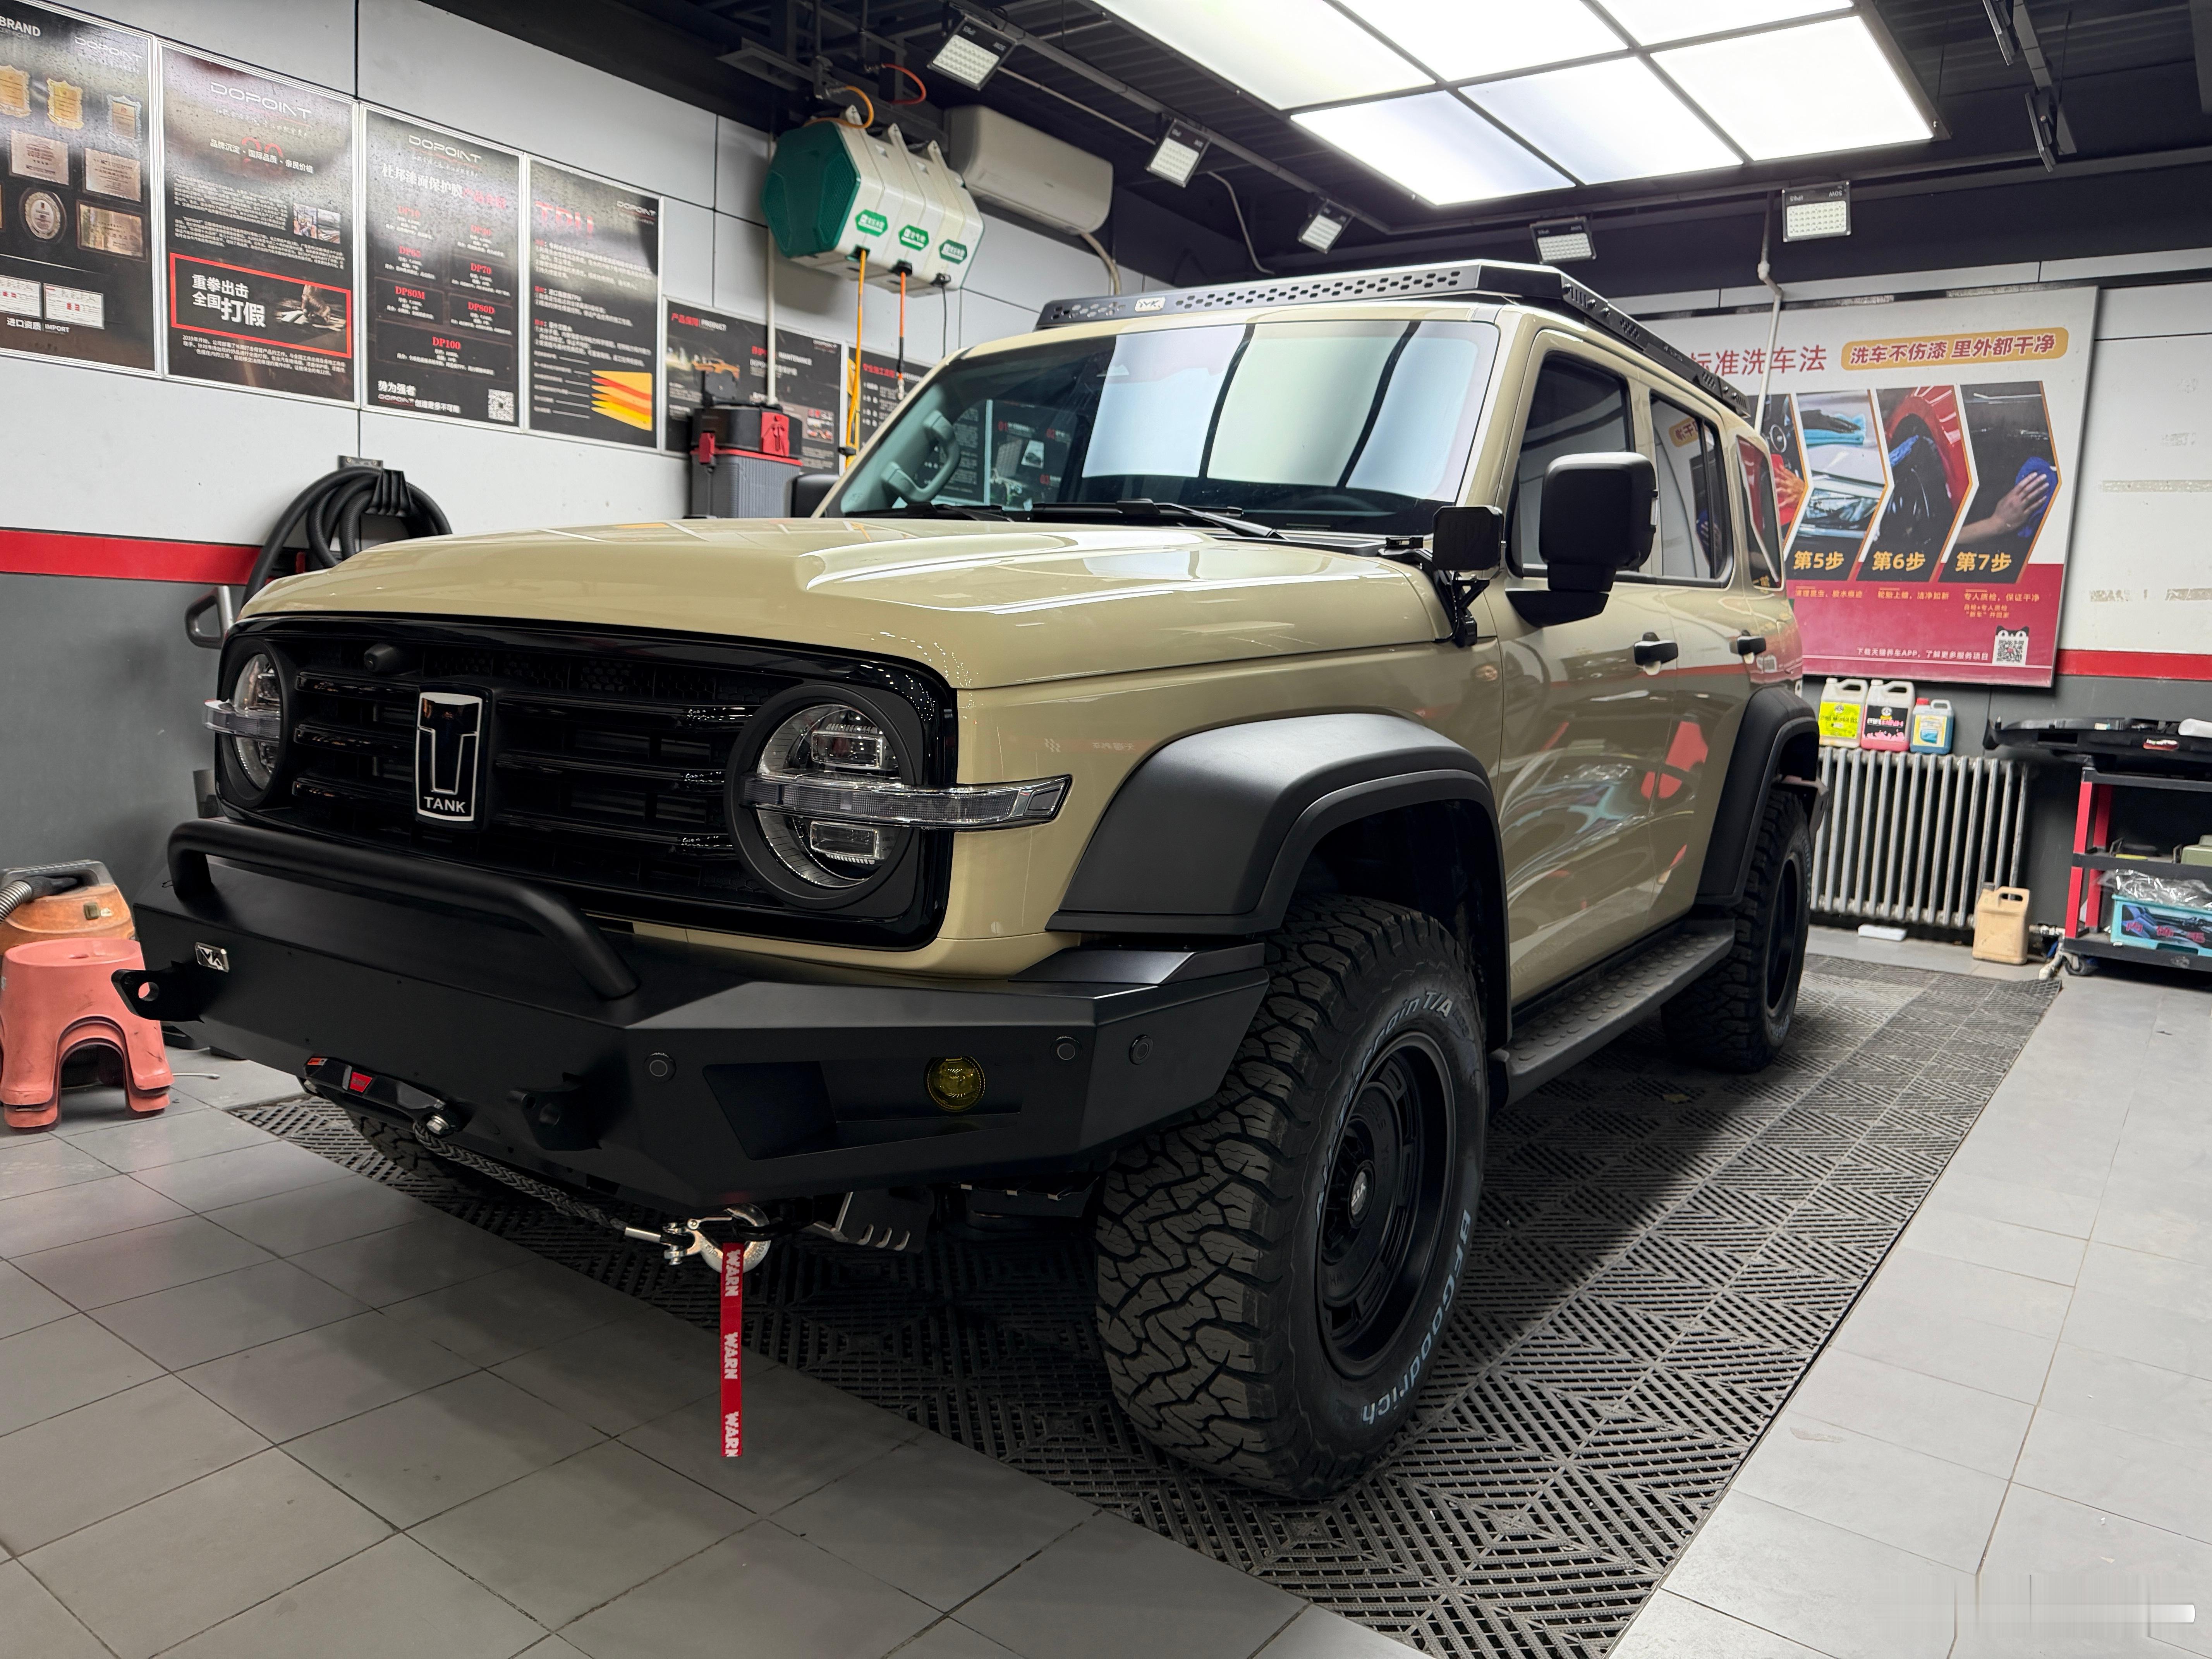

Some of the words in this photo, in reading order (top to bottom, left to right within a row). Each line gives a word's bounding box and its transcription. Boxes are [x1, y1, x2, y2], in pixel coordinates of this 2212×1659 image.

[0, 16, 41, 37] BRAND
[211, 82, 311, 118] DOPOINT
[409, 135, 481, 163] DOPOINT
[471, 263, 492, 275] DP70
[192, 274, 249, 299] 重拳出击
[395, 285, 425, 300] DP80M
[192, 291, 266, 328] 全国打假
[468, 302, 495, 314] DP80D
[7, 318, 41, 331] 进口资质
[45, 324, 70, 333] IMPORT
[432, 336, 461, 350] DP100
[1850, 341, 1947, 364] 洗车不伤漆
[1951, 334, 2055, 358] 里外都干净
[1793, 551, 1844, 570] 第5步
[1872, 551, 1925, 571] 第6步
[1955, 552, 2011, 572] 第7步
[424, 796, 466, 813] TANK
[725, 1249, 740, 1297] WARN
[1362, 1209, 1472, 1426] BFGoodrich
[724, 1331, 738, 1379] WARN
[725, 1411, 739, 1457] WARN
